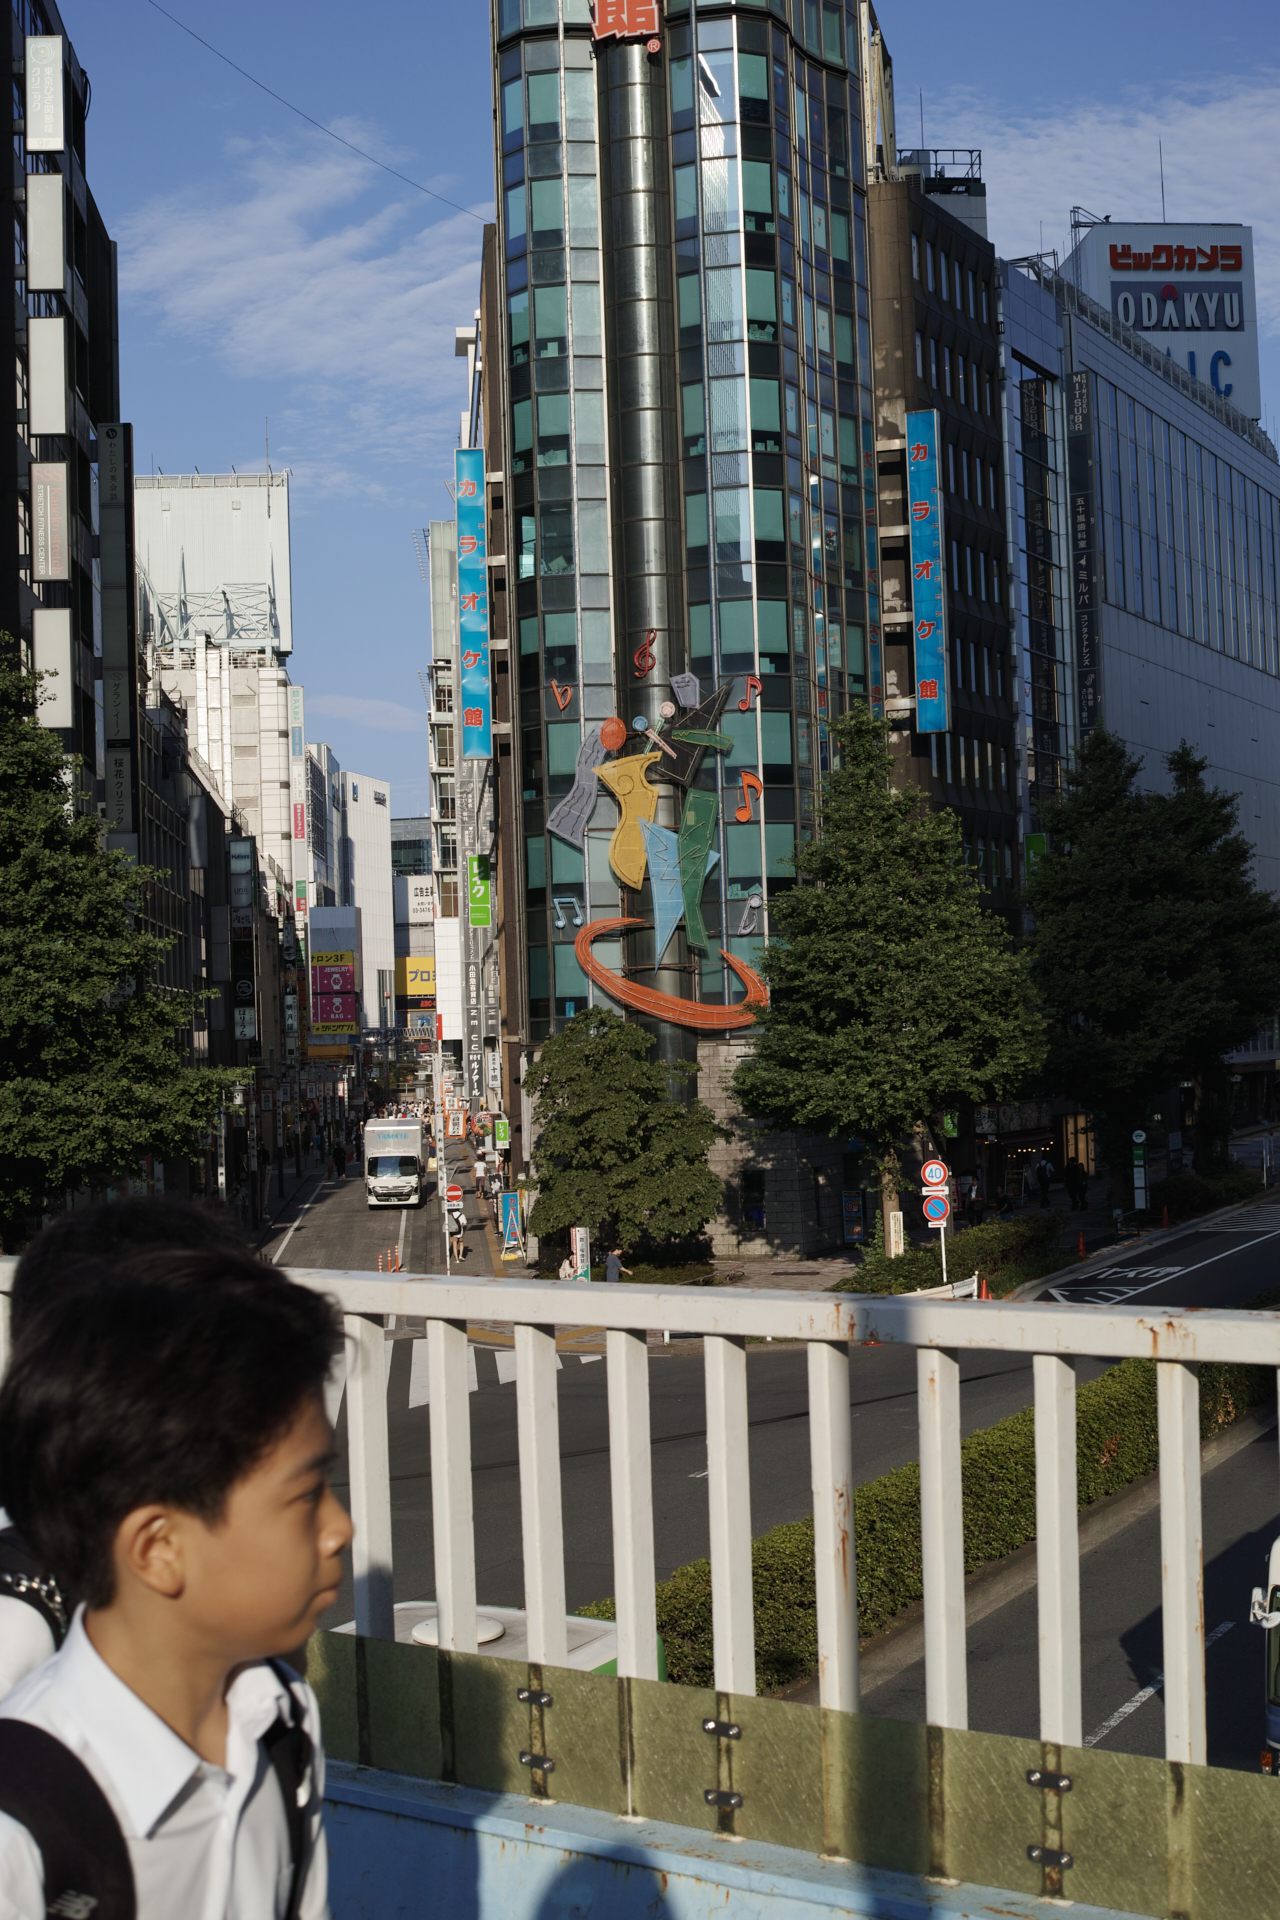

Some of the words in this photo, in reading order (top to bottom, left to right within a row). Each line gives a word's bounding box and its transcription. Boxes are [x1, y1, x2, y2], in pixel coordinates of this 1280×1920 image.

[32, 67, 41, 112] クリニック
[43, 67, 54, 133] 東京ひざ関節症
[1109, 244, 1242, 271] ビックカメラ
[1117, 291, 1240, 328] ODAKYU
[1073, 374, 1083, 431] MITSUBA
[33, 467, 63, 482] SSS
[109, 440, 118, 501] わたしの英会話
[50, 486, 63, 531] Kaneko
[1076, 497, 1087, 549] 五十嵐歯科室
[51, 534, 64, 574] stretch
[909, 442, 940, 701] カラオケ館
[458, 479, 484, 727] カラオケ館
[1078, 570, 1089, 605] ミルバ
[1080, 614, 1091, 666] コンタクトレンズ
[113, 757, 124, 825] 桜花クリニック
[472, 861, 485, 898] レイク
[468, 965, 477, 1004] 小田急百貨店
[471, 1061, 481, 1097] ルノアール
[927, 1167, 942, 1180] 40
